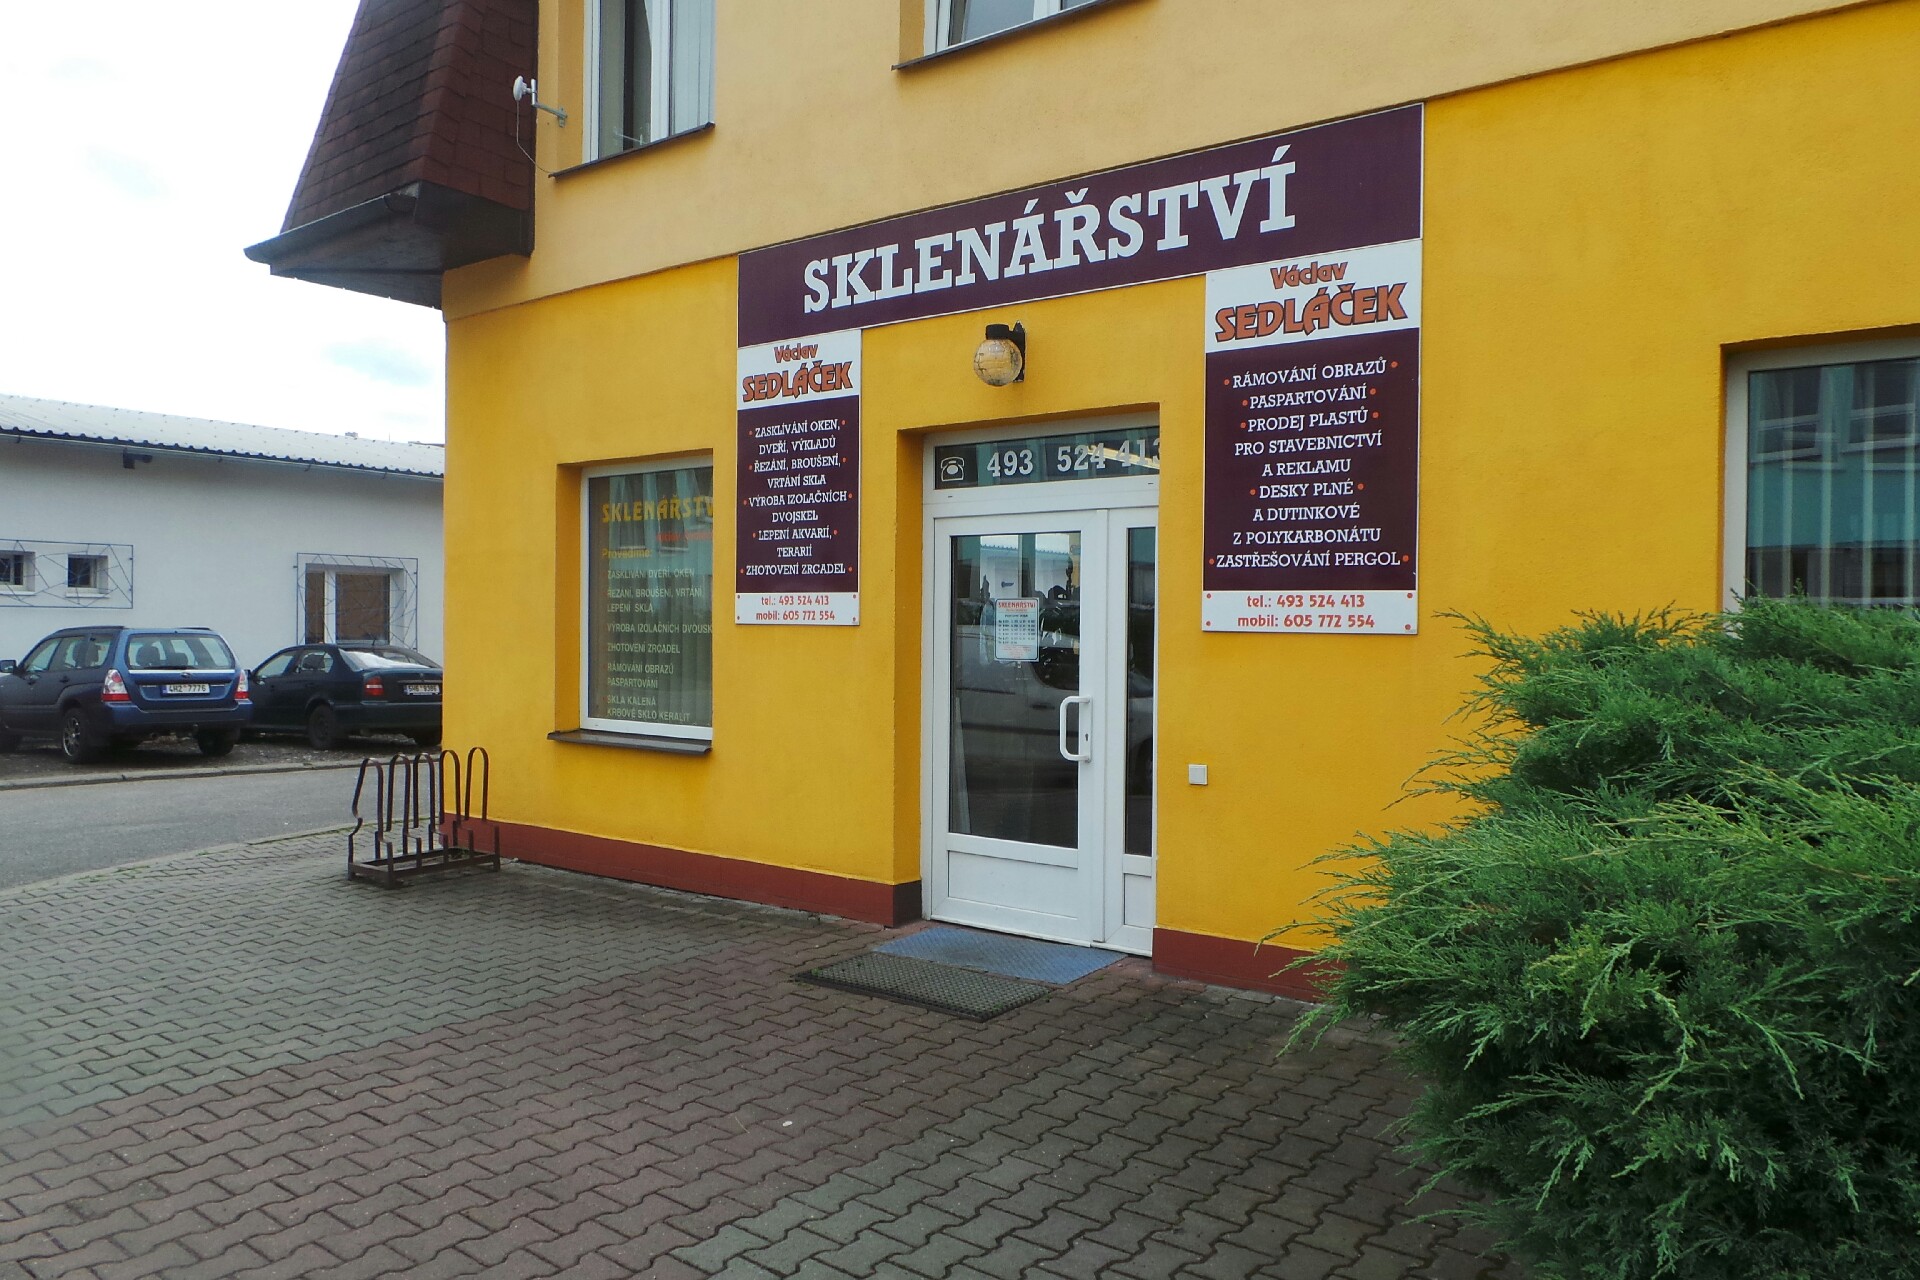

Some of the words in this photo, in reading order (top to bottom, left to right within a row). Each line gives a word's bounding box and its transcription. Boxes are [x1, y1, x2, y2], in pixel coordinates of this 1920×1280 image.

[803, 144, 1297, 313] SKLENÁŘSTVÍ
[1270, 261, 1348, 289] Václav
[1215, 282, 1408, 342] SEDLÁČEK
[774, 343, 818, 363] Václav
[743, 360, 853, 402] SEDLÁČEK
[1233, 364, 1317, 388] RÁMOVÁNÍ
[1321, 356, 1387, 379] OBRAZŮ
[1250, 383, 1367, 409] PASPARTOVÁNÍ
[1248, 414, 1305, 432] PRODEJ
[1309, 405, 1368, 427] PLASTŮ
[755, 420, 807, 438] ZASKLÍVÁNÍ
[810, 419, 840, 434] OKEN,
[759, 440, 789, 455] DVEŘÍ,
[792, 434, 836, 451] VÝKLADŮ
[1234, 441, 1264, 456] PRO
[1269, 429, 1382, 454] STAVEBNICTVÍ
[754, 459, 789, 473] ŘEZÁNÍ,
[791, 453, 841, 470] BROUŠENÍ,
[987, 449, 1034, 477] 493
[1057, 443, 1105, 472] 524
[1262, 464, 1273, 477] A
[1276, 459, 1351, 475] REKLAMU
[767, 474, 801, 489] VRTÁNÍ
[803, 474, 826, 486] SKLA
[1259, 484, 1309, 498] DESKY
[1313, 479, 1354, 496] PLNÉ
[749, 494, 785, 507] VÝROBA
[787, 490, 847, 505] IZOLAČNÍCH
[772, 510, 818, 524] DVOJSKEL
[1252, 508, 1264, 521] A
[1267, 502, 1360, 520] DUTINKOVÉ
[758, 527, 789, 540] LEPENÍ
[792, 525, 832, 540] AKVARIÍ,
[1233, 532, 1241, 545] Z
[1246, 526, 1381, 544] POLYKARBONÁTU
[776, 543, 812, 557] TERARIÍ
[1216, 550, 1330, 568] ZASTŘEŠOVÁNÍ
[1335, 552, 1400, 566] PERGOL
[674, 568, 694, 578] OKEN
[746, 562, 799, 575] ZHOTOVENÍ
[801, 563, 845, 574] ZRCADEL
[779, 596, 794, 605] 493
[797, 596, 812, 605] 524
[815, 596, 829, 605] 413
[1247, 595, 1271, 607] tel.:
[1277, 595, 1304, 607] 493
[1309, 595, 1335, 607] 524
[1341, 595, 1365, 607] 413
[756, 611, 780, 620] mobil:
[782, 611, 800, 620] 605
[819, 611, 835, 620] 554
[1238, 615, 1278, 627] mobil:
[1284, 615, 1313, 627] 605
[1318, 615, 1341, 627] 772
[1347, 615, 1375, 627] 554
[638, 622, 679, 633] IZOLAČNÍCH
[648, 644, 680, 653] ZRCADEL
[638, 709, 657, 719] SKLO
